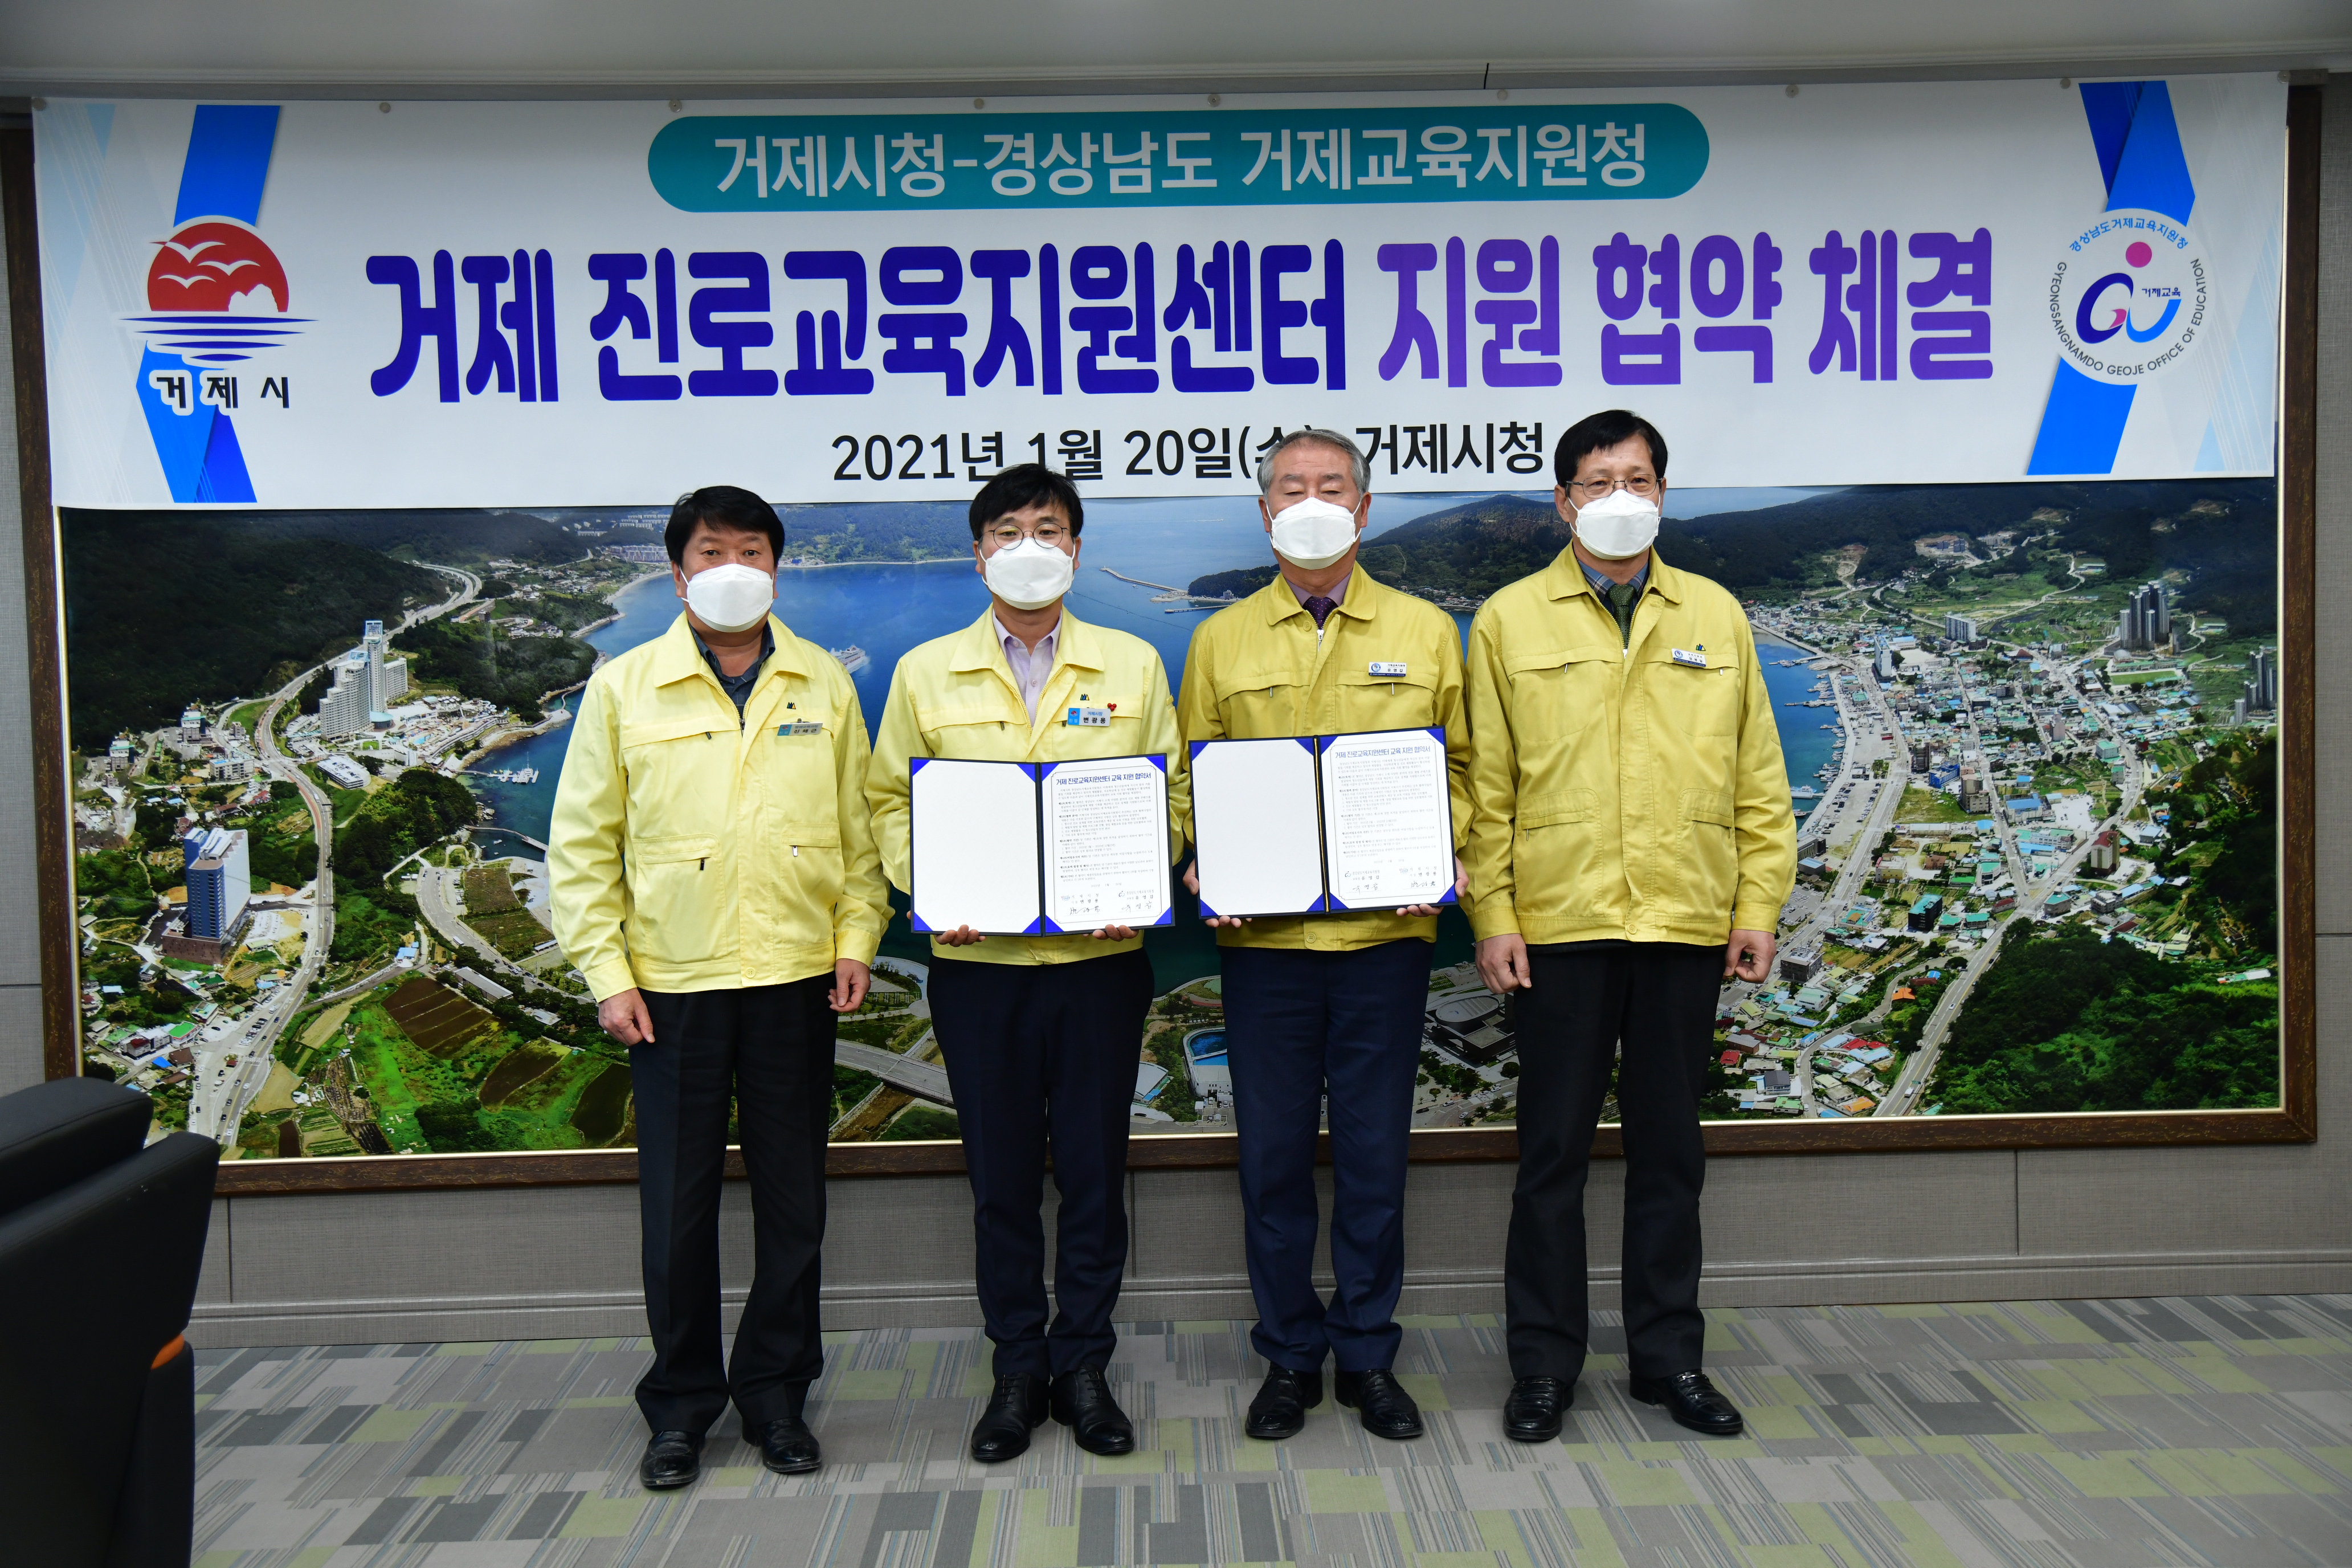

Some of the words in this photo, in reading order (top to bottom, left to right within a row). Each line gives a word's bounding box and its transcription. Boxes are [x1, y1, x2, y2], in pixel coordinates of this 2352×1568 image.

[714, 130, 1218, 198] 거제시청-경상남도
[1240, 121, 1647, 191] 거제교육지원청
[2069, 218, 2188, 251] 경상남도거제교육지원청
[2142, 287, 2180, 297] 거제교육
[365, 248, 559, 403] 거제
[587, 239, 1346, 402] 진로교육지원센터
[1377, 235, 1563, 388] 지원
[1592, 231, 1783, 386] 협약
[1808, 227, 1993, 381] 체결
[2049, 262, 2103, 371] GYEONGSANGNAMDO
[2107, 364, 2144, 375] GEOJE
[2147, 342, 2184, 370] OFFICE
[2182, 327, 2195, 343] OF
[2190, 258, 2206, 326] EDUCATION
[156, 376, 289, 409] 거제시
[832, 431, 1003, 481] 2021년
[1027, 430, 1103, 480] 1월
[1355, 421, 1543, 475] 거제시청
[1347, 749, 1389, 758] 진로교육지원센터
[1068, 775, 1110, 785] 진로교육지원센터
